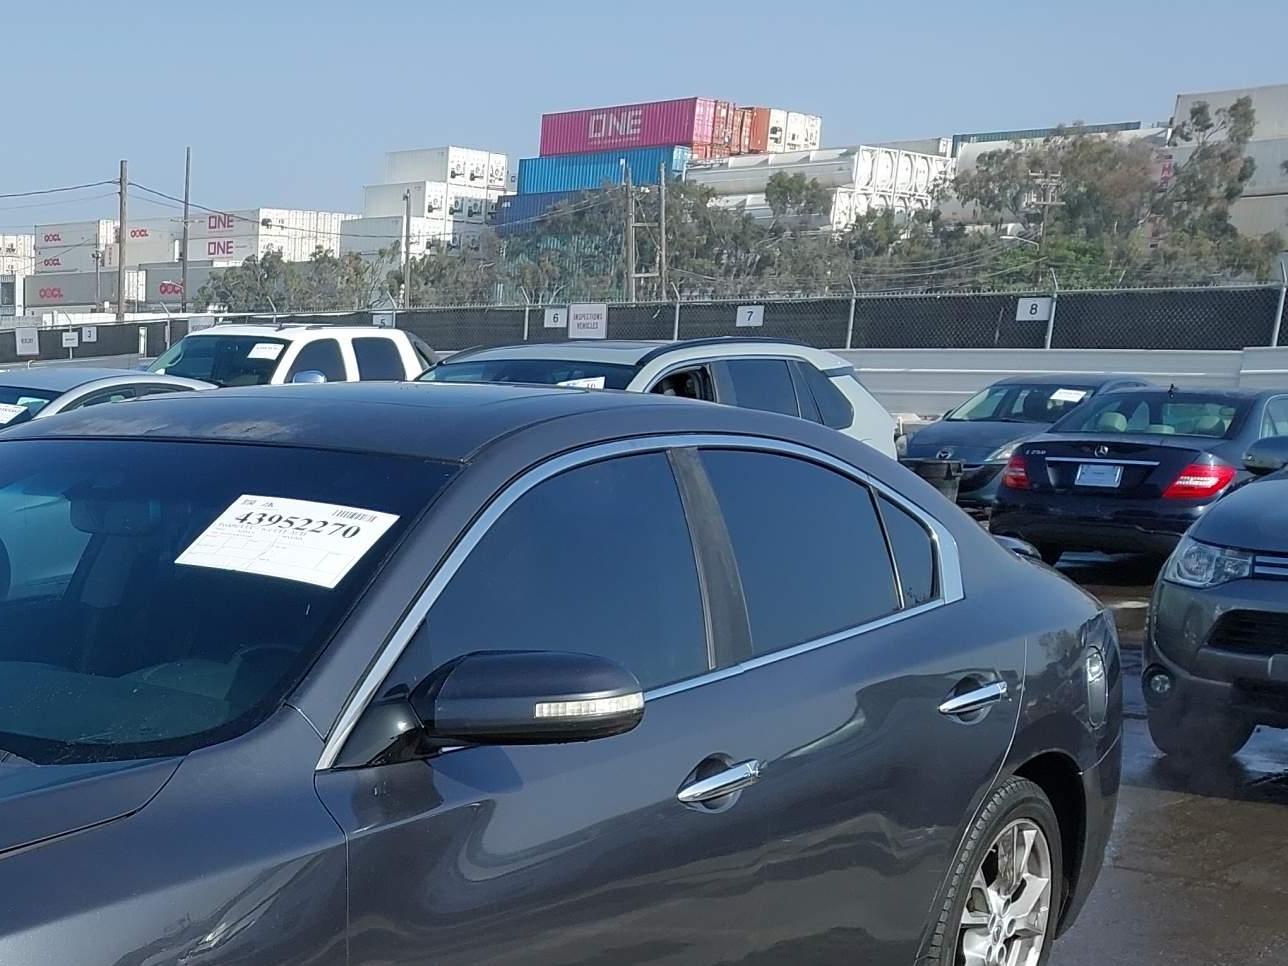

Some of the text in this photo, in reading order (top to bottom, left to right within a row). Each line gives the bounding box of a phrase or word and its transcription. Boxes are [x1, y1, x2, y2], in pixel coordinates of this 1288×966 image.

[588, 110, 642, 138] ONE
[208, 214, 234, 229] ONE
[207, 240, 233, 255] ONE
[746, 310, 754, 321] 7
[1029, 303, 1038, 315] 8
[552, 312, 559, 323] 6
[234, 511, 361, 538] 43952270
